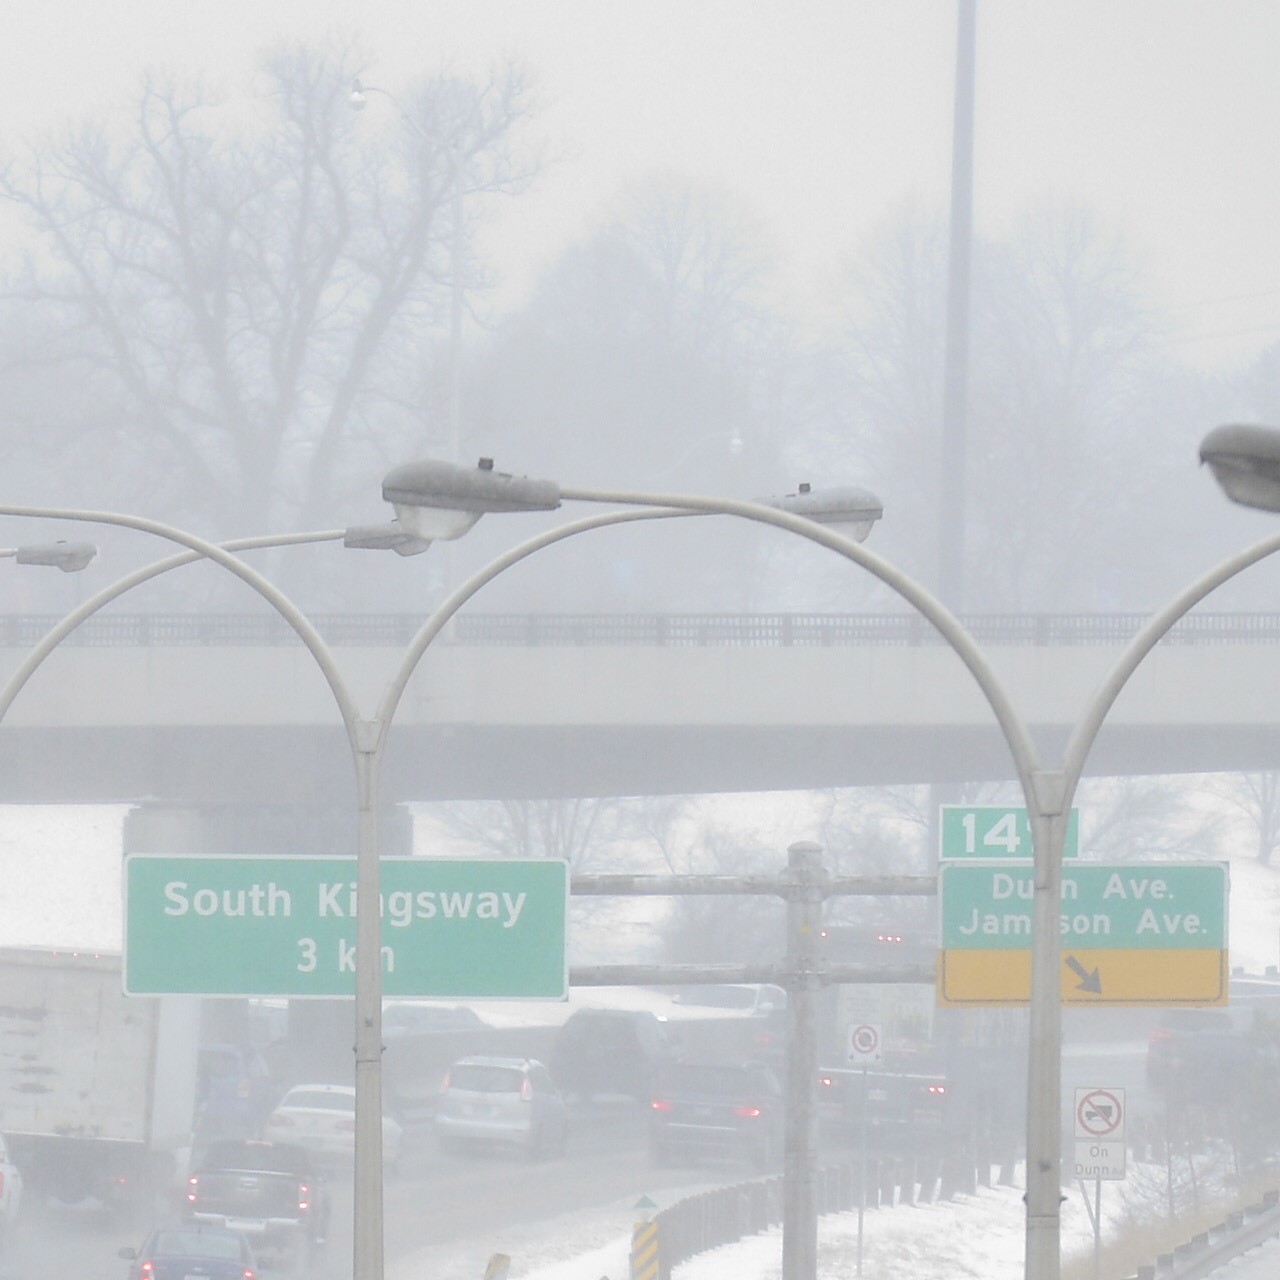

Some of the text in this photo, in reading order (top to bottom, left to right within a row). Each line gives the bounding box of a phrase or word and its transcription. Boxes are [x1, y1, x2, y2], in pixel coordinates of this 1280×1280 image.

[993, 873, 1175, 900] Dun Ave.
[164, 881, 527, 928] South Kigsway
[959, 908, 1208, 935] Jamson Ave.
[297, 938, 317, 973] 3
[1090, 1146, 1109, 1157] On
[1076, 1163, 1109, 1176] Dunn
